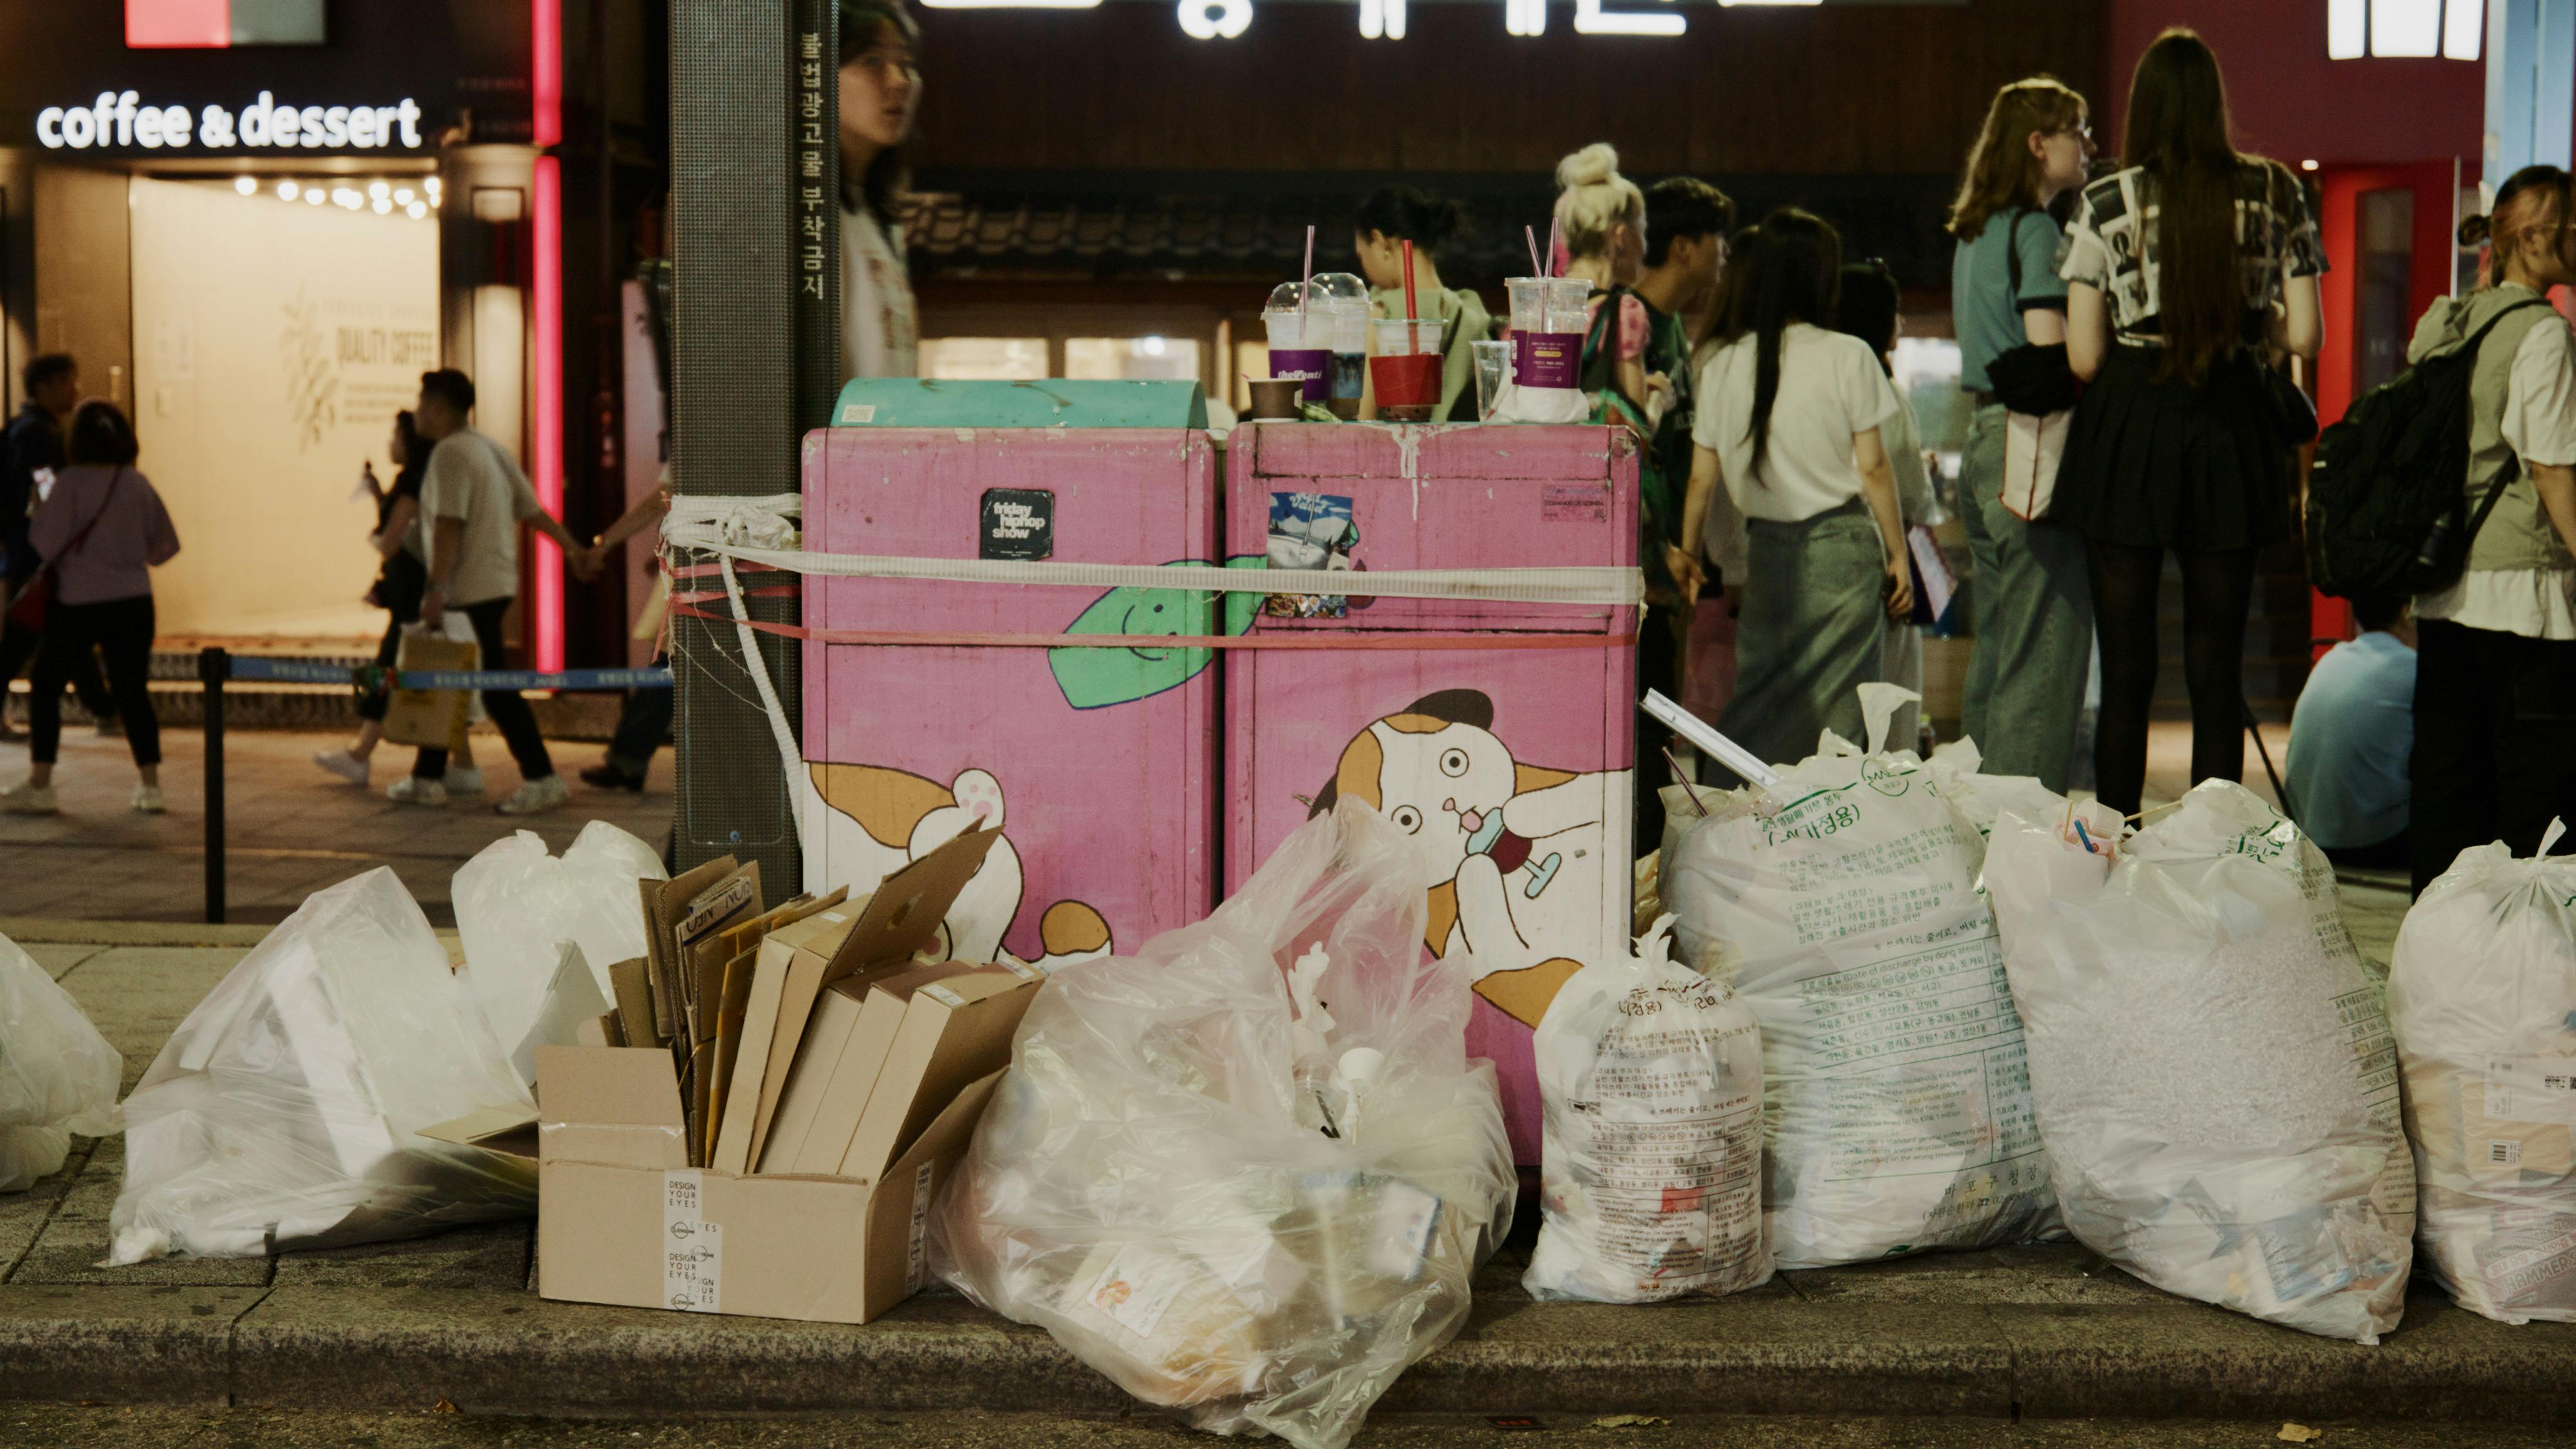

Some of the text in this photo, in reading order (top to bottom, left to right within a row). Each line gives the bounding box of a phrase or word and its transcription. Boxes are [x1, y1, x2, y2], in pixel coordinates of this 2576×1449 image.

[36, 90, 422, 149] coffee & dessert
[801, 186, 825, 301] 부착금지
[993, 502, 1033, 518] friday
[1000, 514, 1046, 530] hiphop
[992, 527, 1030, 539] show
[1880, 957, 1921, 972] discharge
[1935, 950, 1957, 959] dong
[1913, 1153, 1934, 1161] wrong
[670, 1181, 696, 1190] DESIGN
[670, 1191, 696, 1199] YOUR
[670, 1199, 696, 1208] EYES
[670, 1253, 696, 1262] DESIGN
[670, 1262, 696, 1270] YOUR
[670, 1270, 696, 1280] EYES
